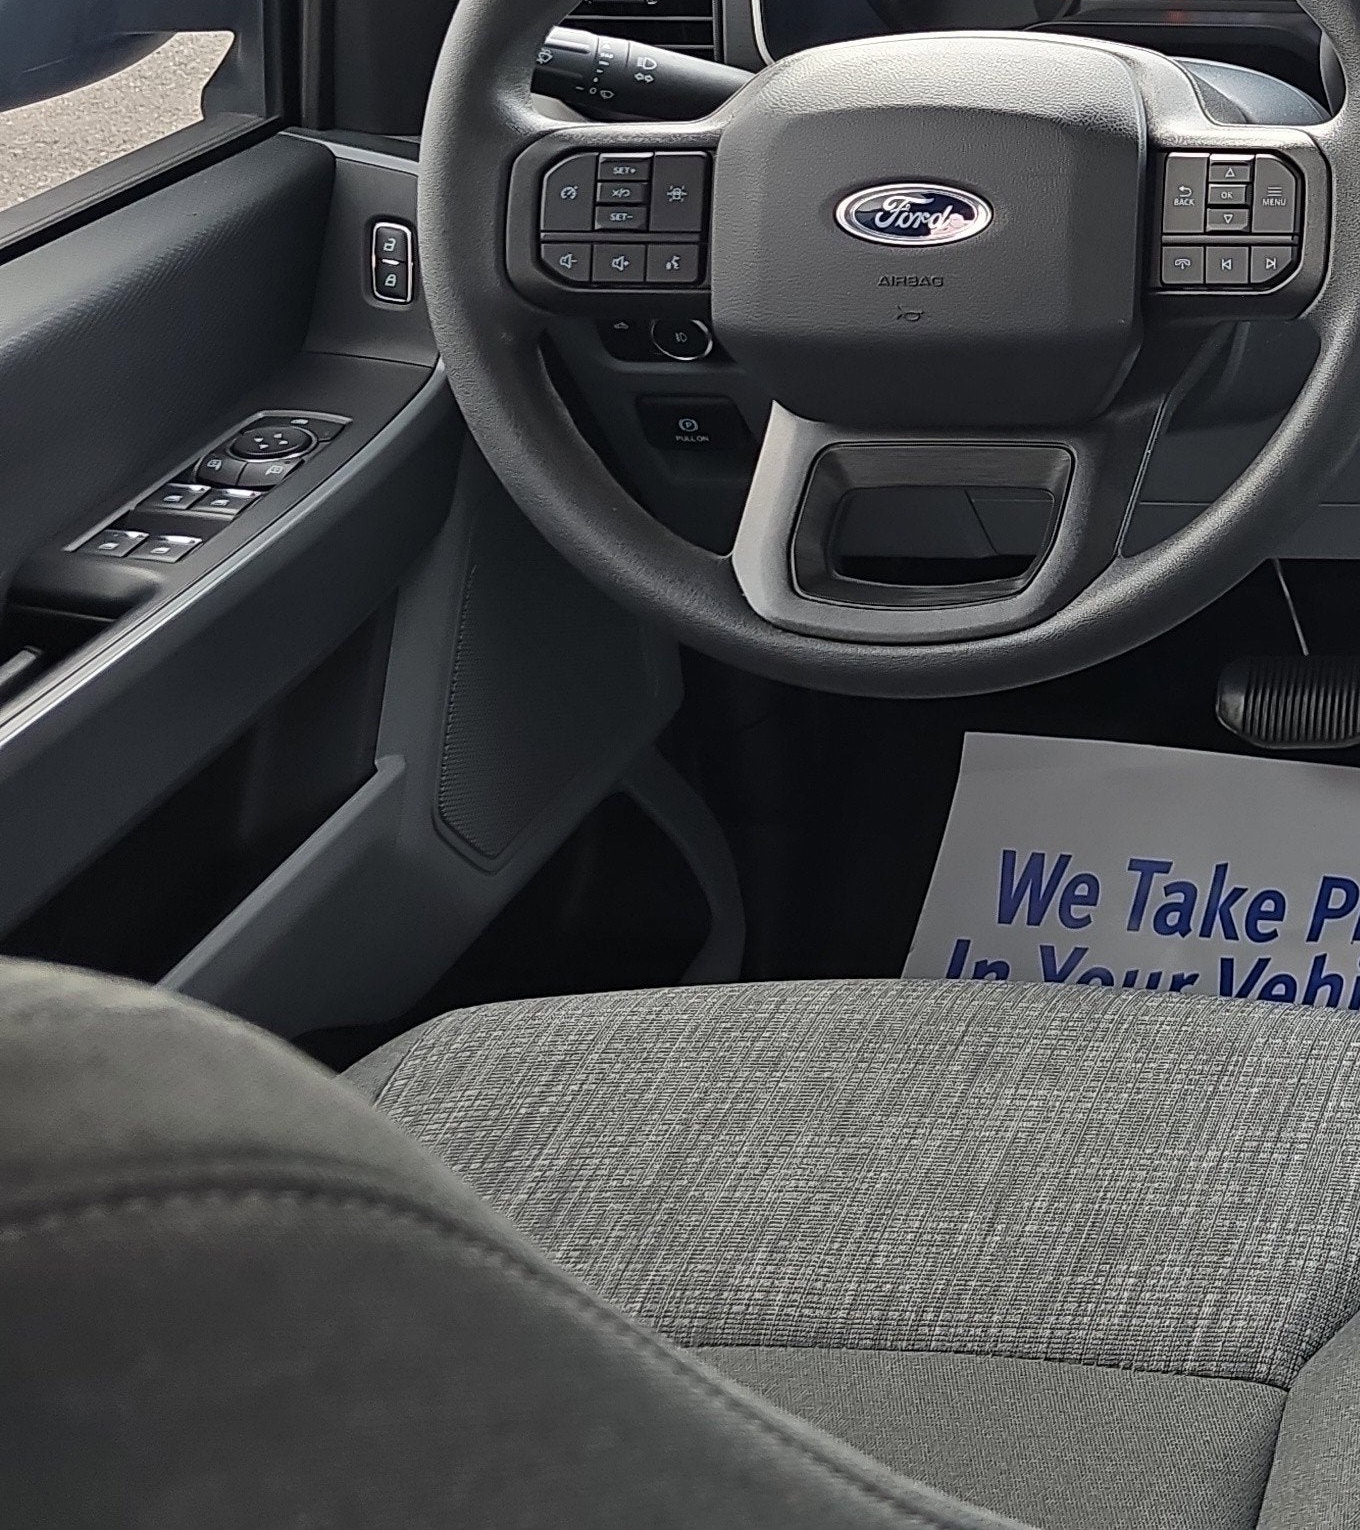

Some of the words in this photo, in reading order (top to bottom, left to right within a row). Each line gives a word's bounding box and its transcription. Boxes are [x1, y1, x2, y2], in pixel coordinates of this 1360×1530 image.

[1221, 191, 1233, 199] OK
[1174, 198, 1195, 206] BACK
[1262, 198, 1287, 206] MENU
[877, 275, 944, 288] AIRBAG
[997, 848, 1100, 930] We
[1125, 856, 1287, 944] Take
